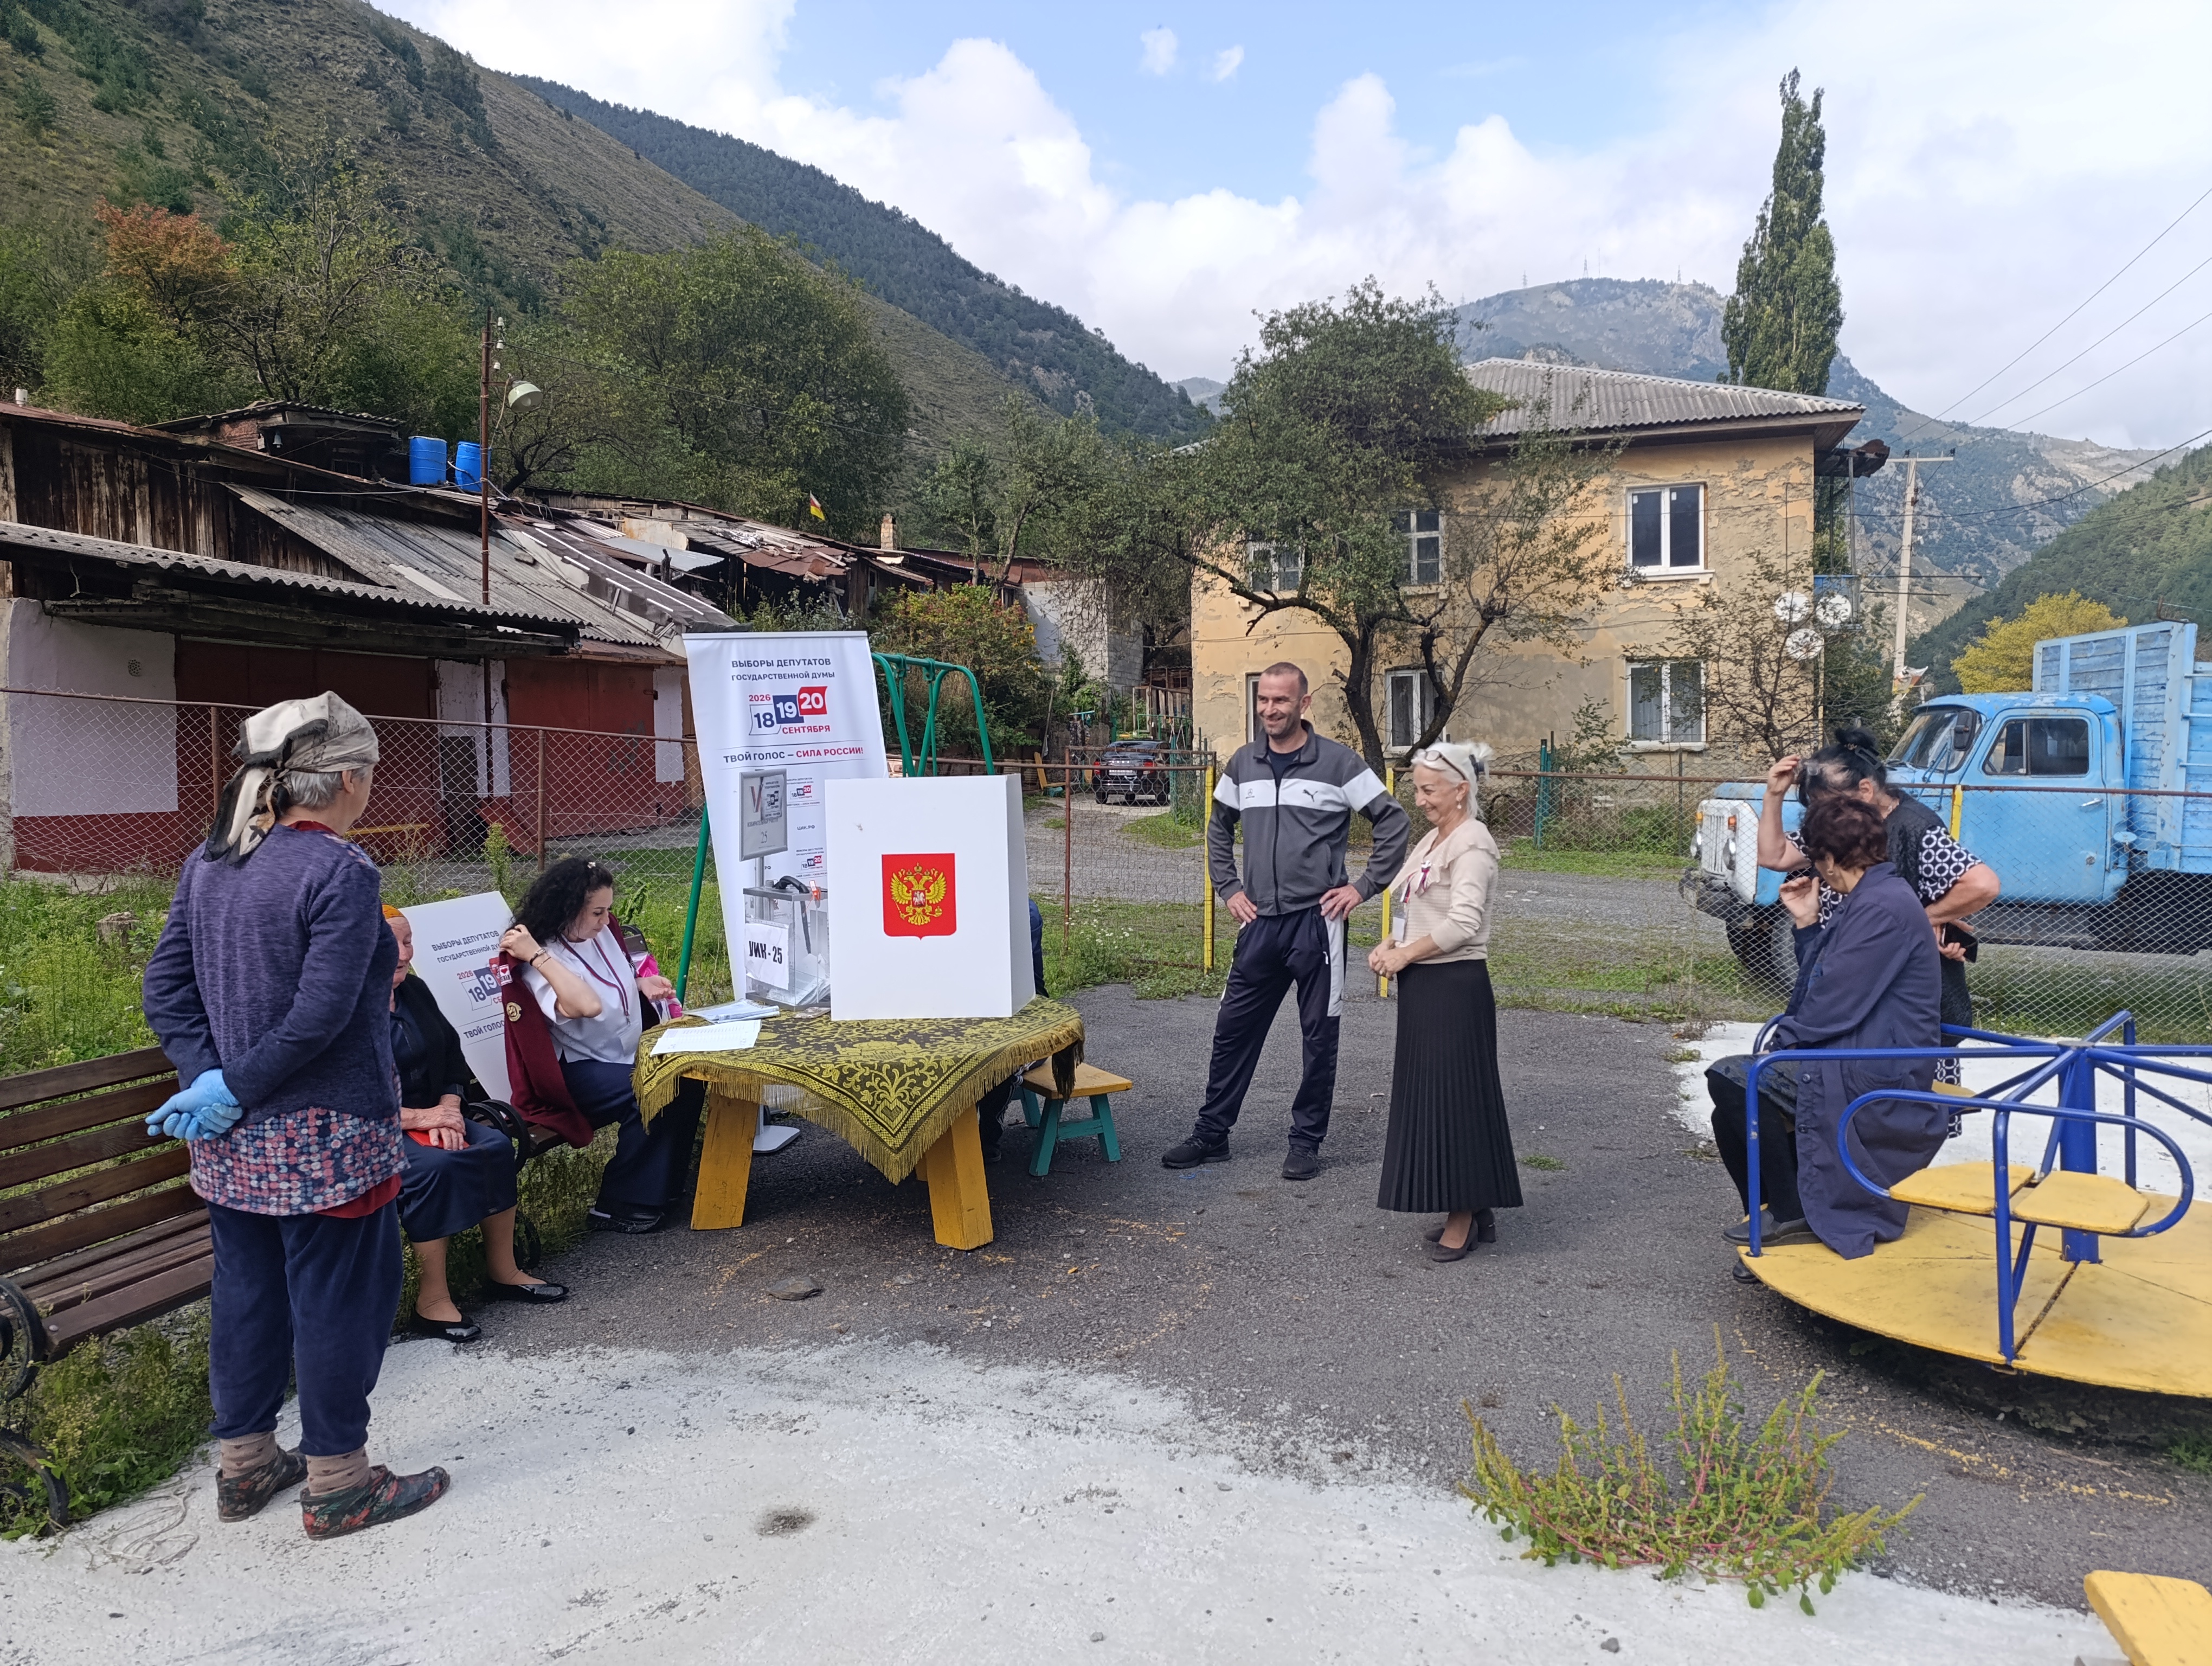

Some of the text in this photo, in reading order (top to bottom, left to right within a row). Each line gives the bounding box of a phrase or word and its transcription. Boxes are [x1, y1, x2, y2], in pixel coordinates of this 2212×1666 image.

[732, 658, 831, 668] ВЫБОРЫ ДЕПУТАТОВ
[732, 671, 809, 681] ГОСУДАРСТВЕННОЙ
[754, 693, 824, 728] 18 19 20
[782, 725, 830, 734] СЕНТЯБРЯ
[724, 752, 751, 763] ТВОЙ
[754, 752, 785, 760] ГОЛОС
[796, 749, 821, 758] СИЛА
[824, 747, 864, 756] РОССИИ!
[761, 830, 768, 843] 25
[432, 930, 499, 951] ВЫБОРЫ ДЕПУТАТОВ
[437, 945, 491, 963] ГОСУДАРСТВЕННОЙ
[749, 940, 767, 959] УИК
[773, 946, 782, 964] 25
[456, 970, 473, 979] 2026
[468, 986, 486, 1003] 18
[479, 973, 497, 990] 19
[464, 1020, 505, 1039] ТВОЙ ГОЛОС
